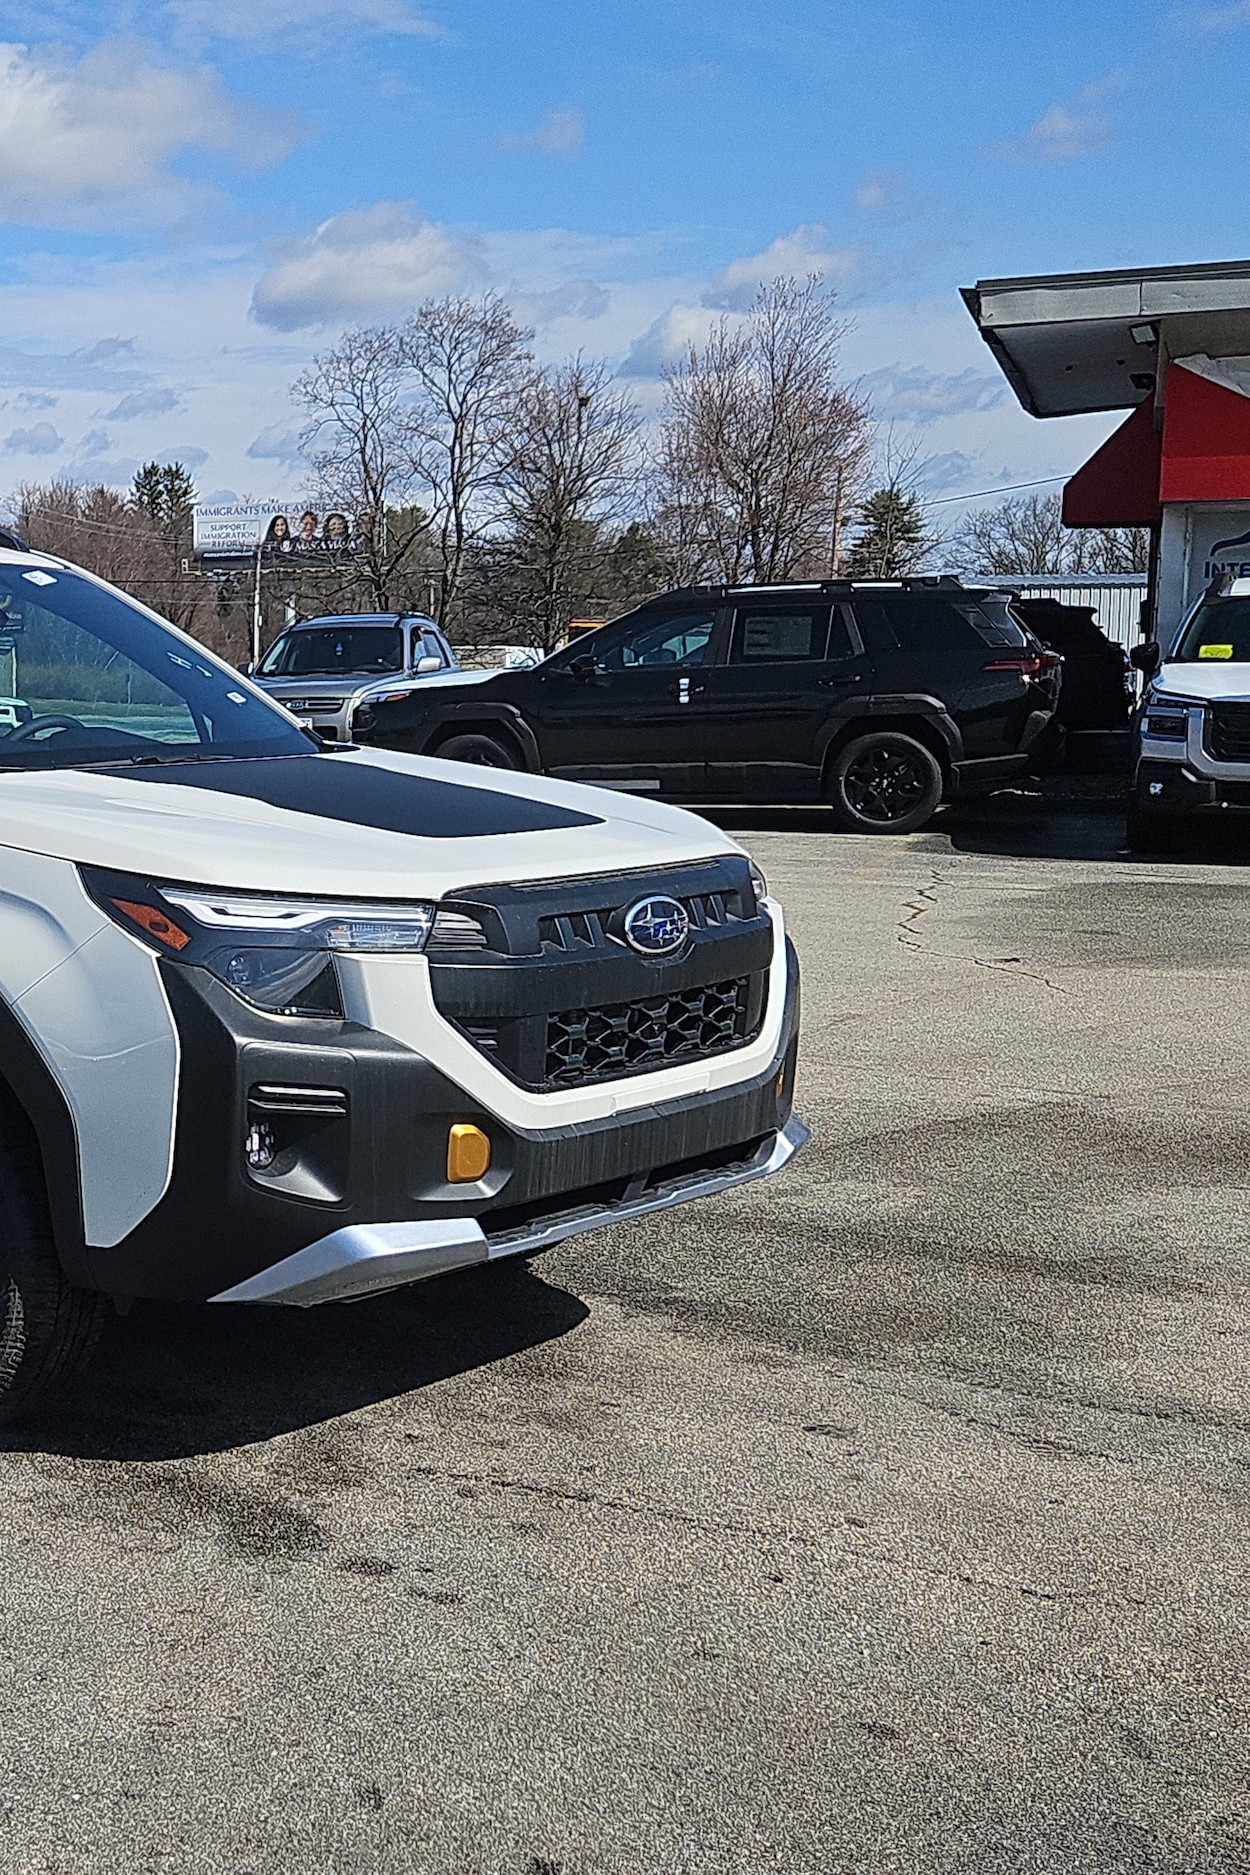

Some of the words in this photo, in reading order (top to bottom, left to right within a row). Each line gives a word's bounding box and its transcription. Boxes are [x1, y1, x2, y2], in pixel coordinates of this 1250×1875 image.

[196, 505, 259, 517] IMMIGRANTS
[261, 504, 291, 515] MAKE
[210, 523, 247, 531] SUPPORT
[200, 531, 257, 540] IMMIGRATION
[211, 540, 245, 548] REFORM
